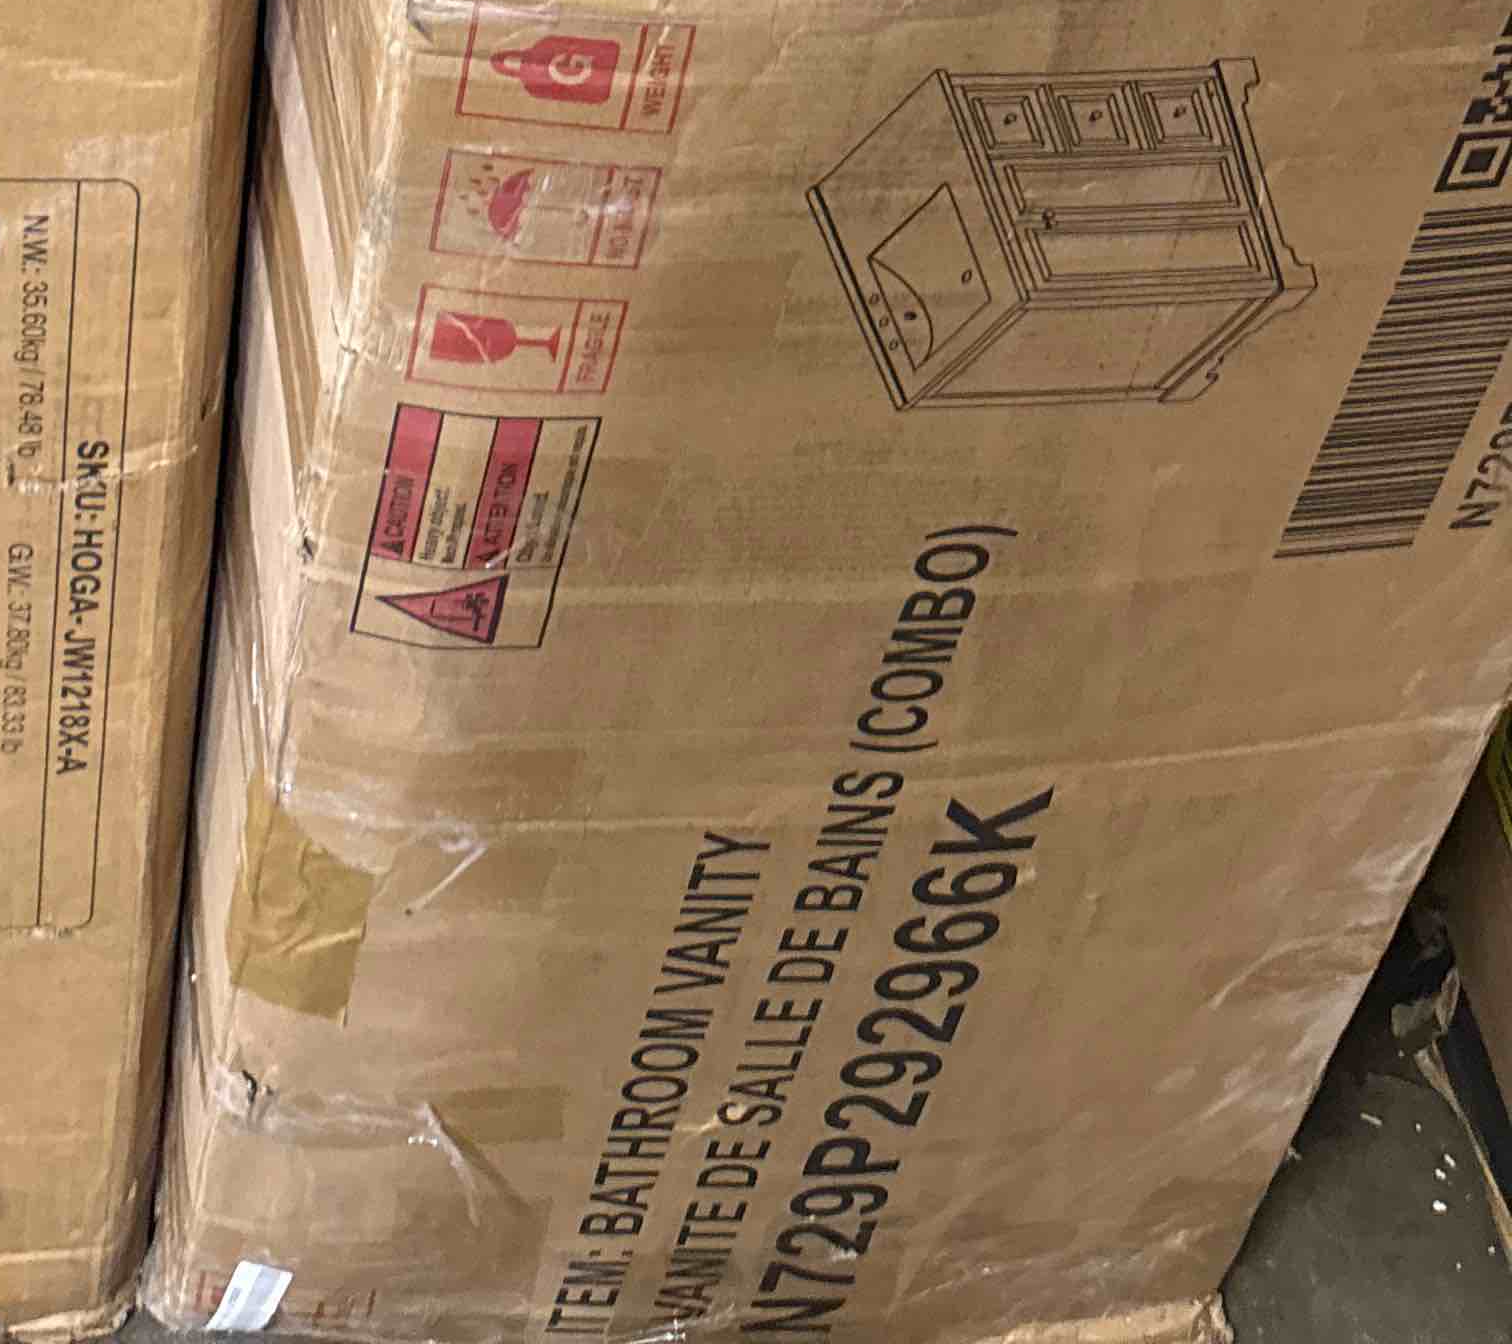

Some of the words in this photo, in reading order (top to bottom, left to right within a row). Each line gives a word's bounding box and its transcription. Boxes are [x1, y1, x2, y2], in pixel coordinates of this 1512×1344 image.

[644, 40, 674, 118] WEIGHT
[14, 280, 48, 363] 35.60kg
[574, 311, 610, 386] FRAGILE
[18, 380, 45, 436] 78.48
[75, 440, 110, 522] SKU:
[383, 473, 414, 539] CAUTION
[0, 600, 33, 671] 37.80kg
[850, 523, 1019, 755] (COMBO)
[0, 738, 23, 754] lb
[2, 685, 29, 734] 83.33
[795, 768, 906, 913] BAINS
[654, 830, 772, 997] VANITY
[768, 926, 849, 988] DE
[717, 996, 823, 1128] SALLE
[740, 784, 1055, 1338] N729P292966K
[580, 1007, 712, 1238] BATHROOM
[696, 1138, 772, 1192] DE
[544, 1248, 631, 1336] ITEM:
